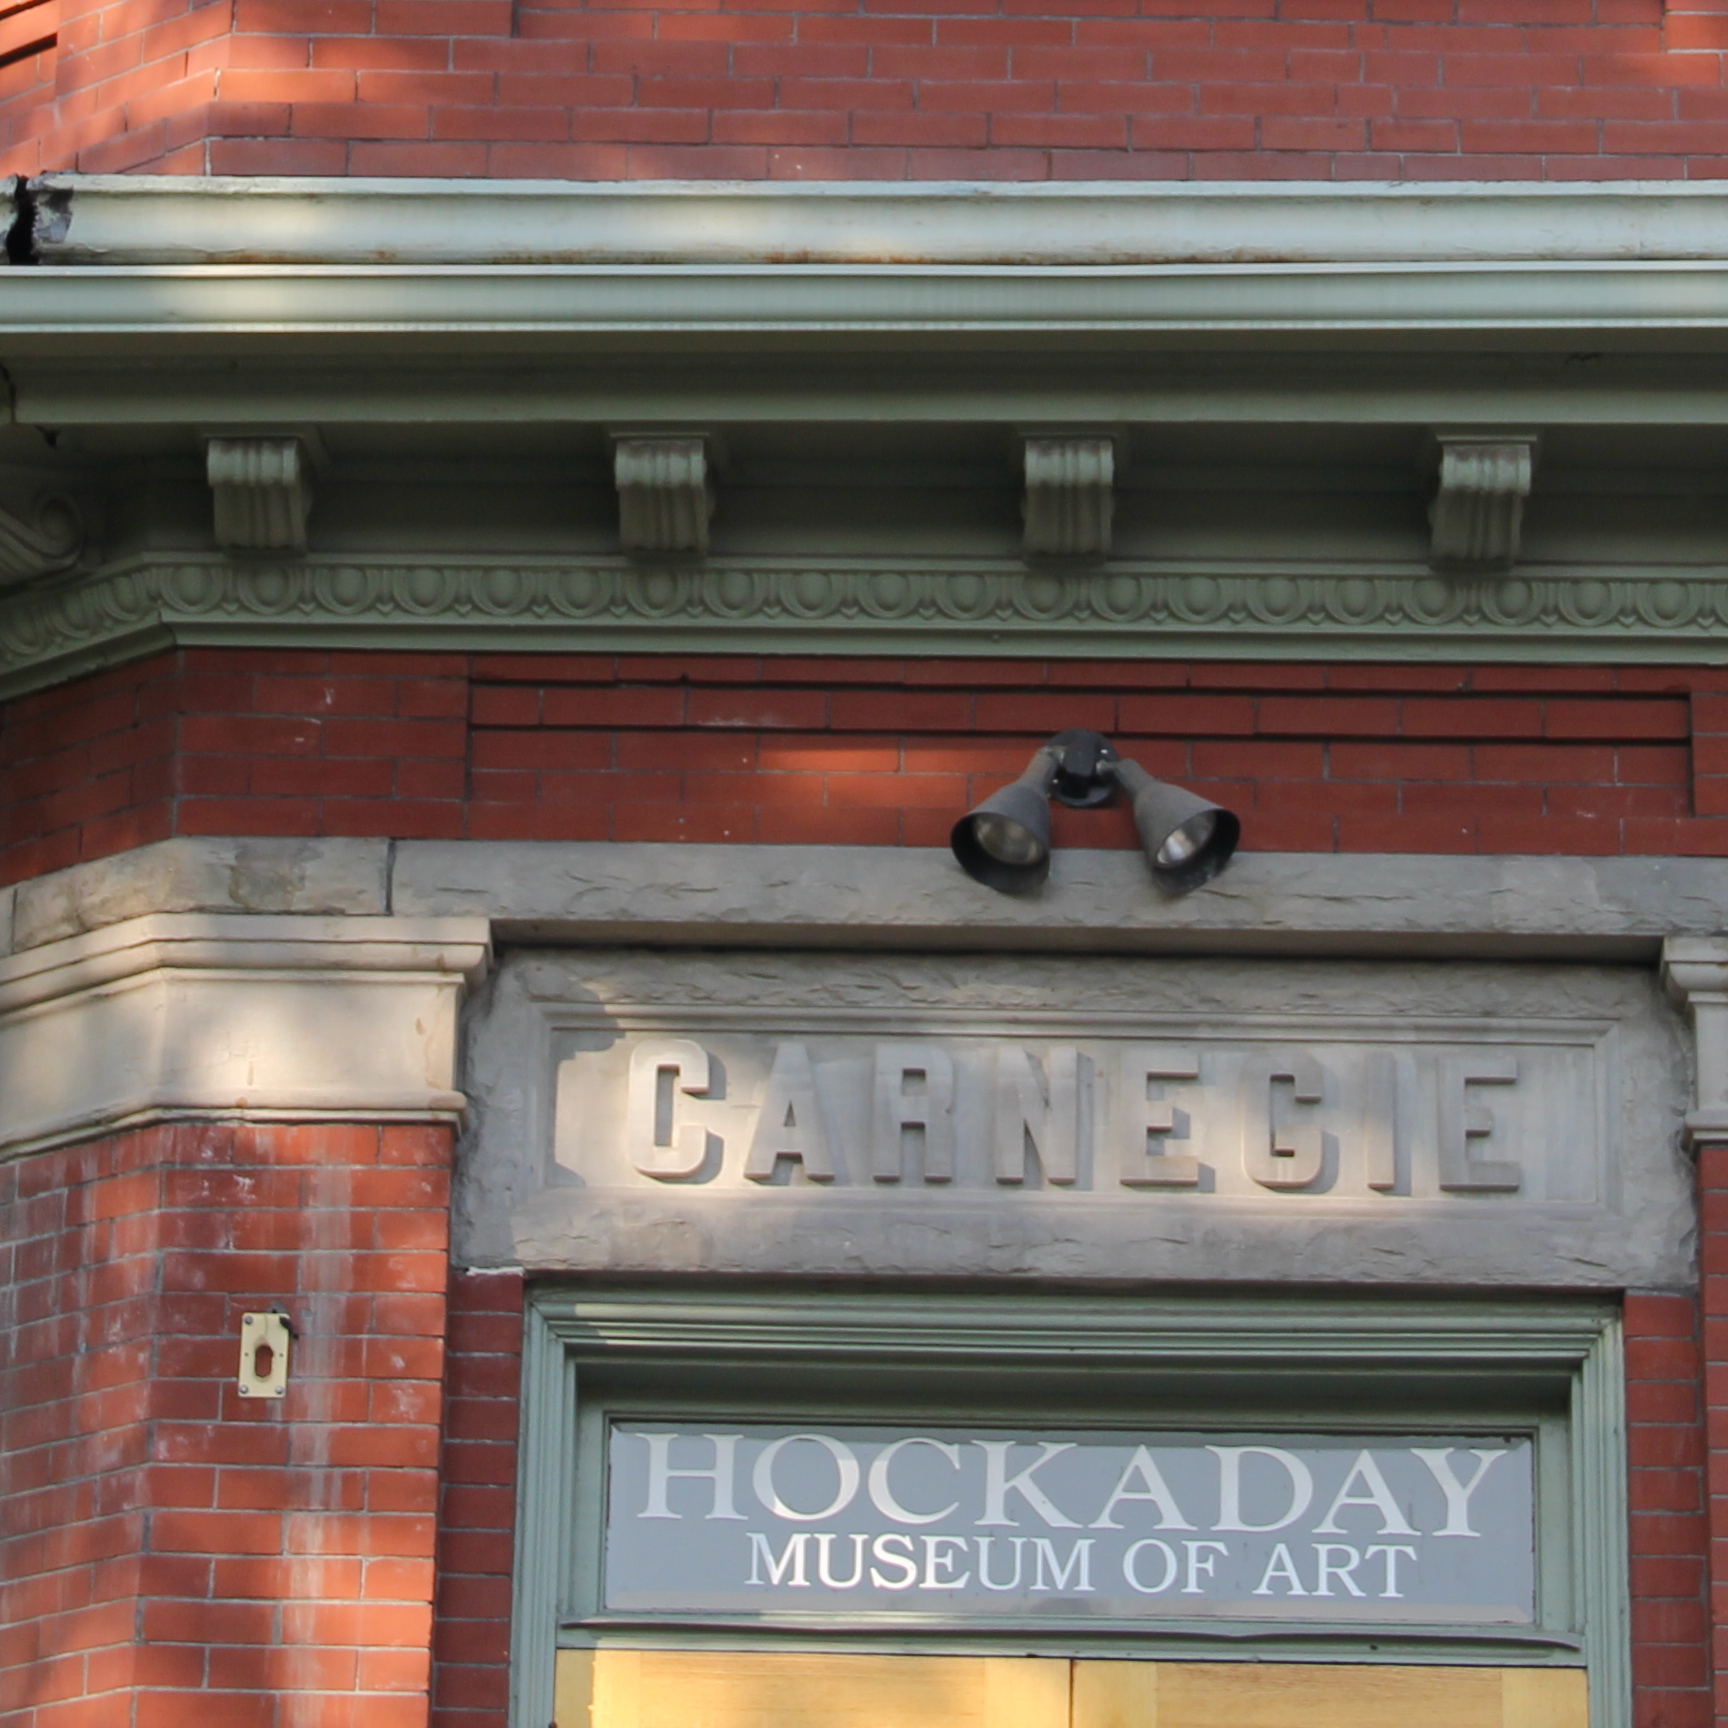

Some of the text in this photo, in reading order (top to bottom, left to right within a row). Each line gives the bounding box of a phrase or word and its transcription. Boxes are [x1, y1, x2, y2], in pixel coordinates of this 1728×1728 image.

[628, 1038, 1520, 1193] CARNEGIE
[634, 1432, 1510, 1539] HOCKADAY
[746, 1531, 1419, 1599] MUSEUM OF ART
